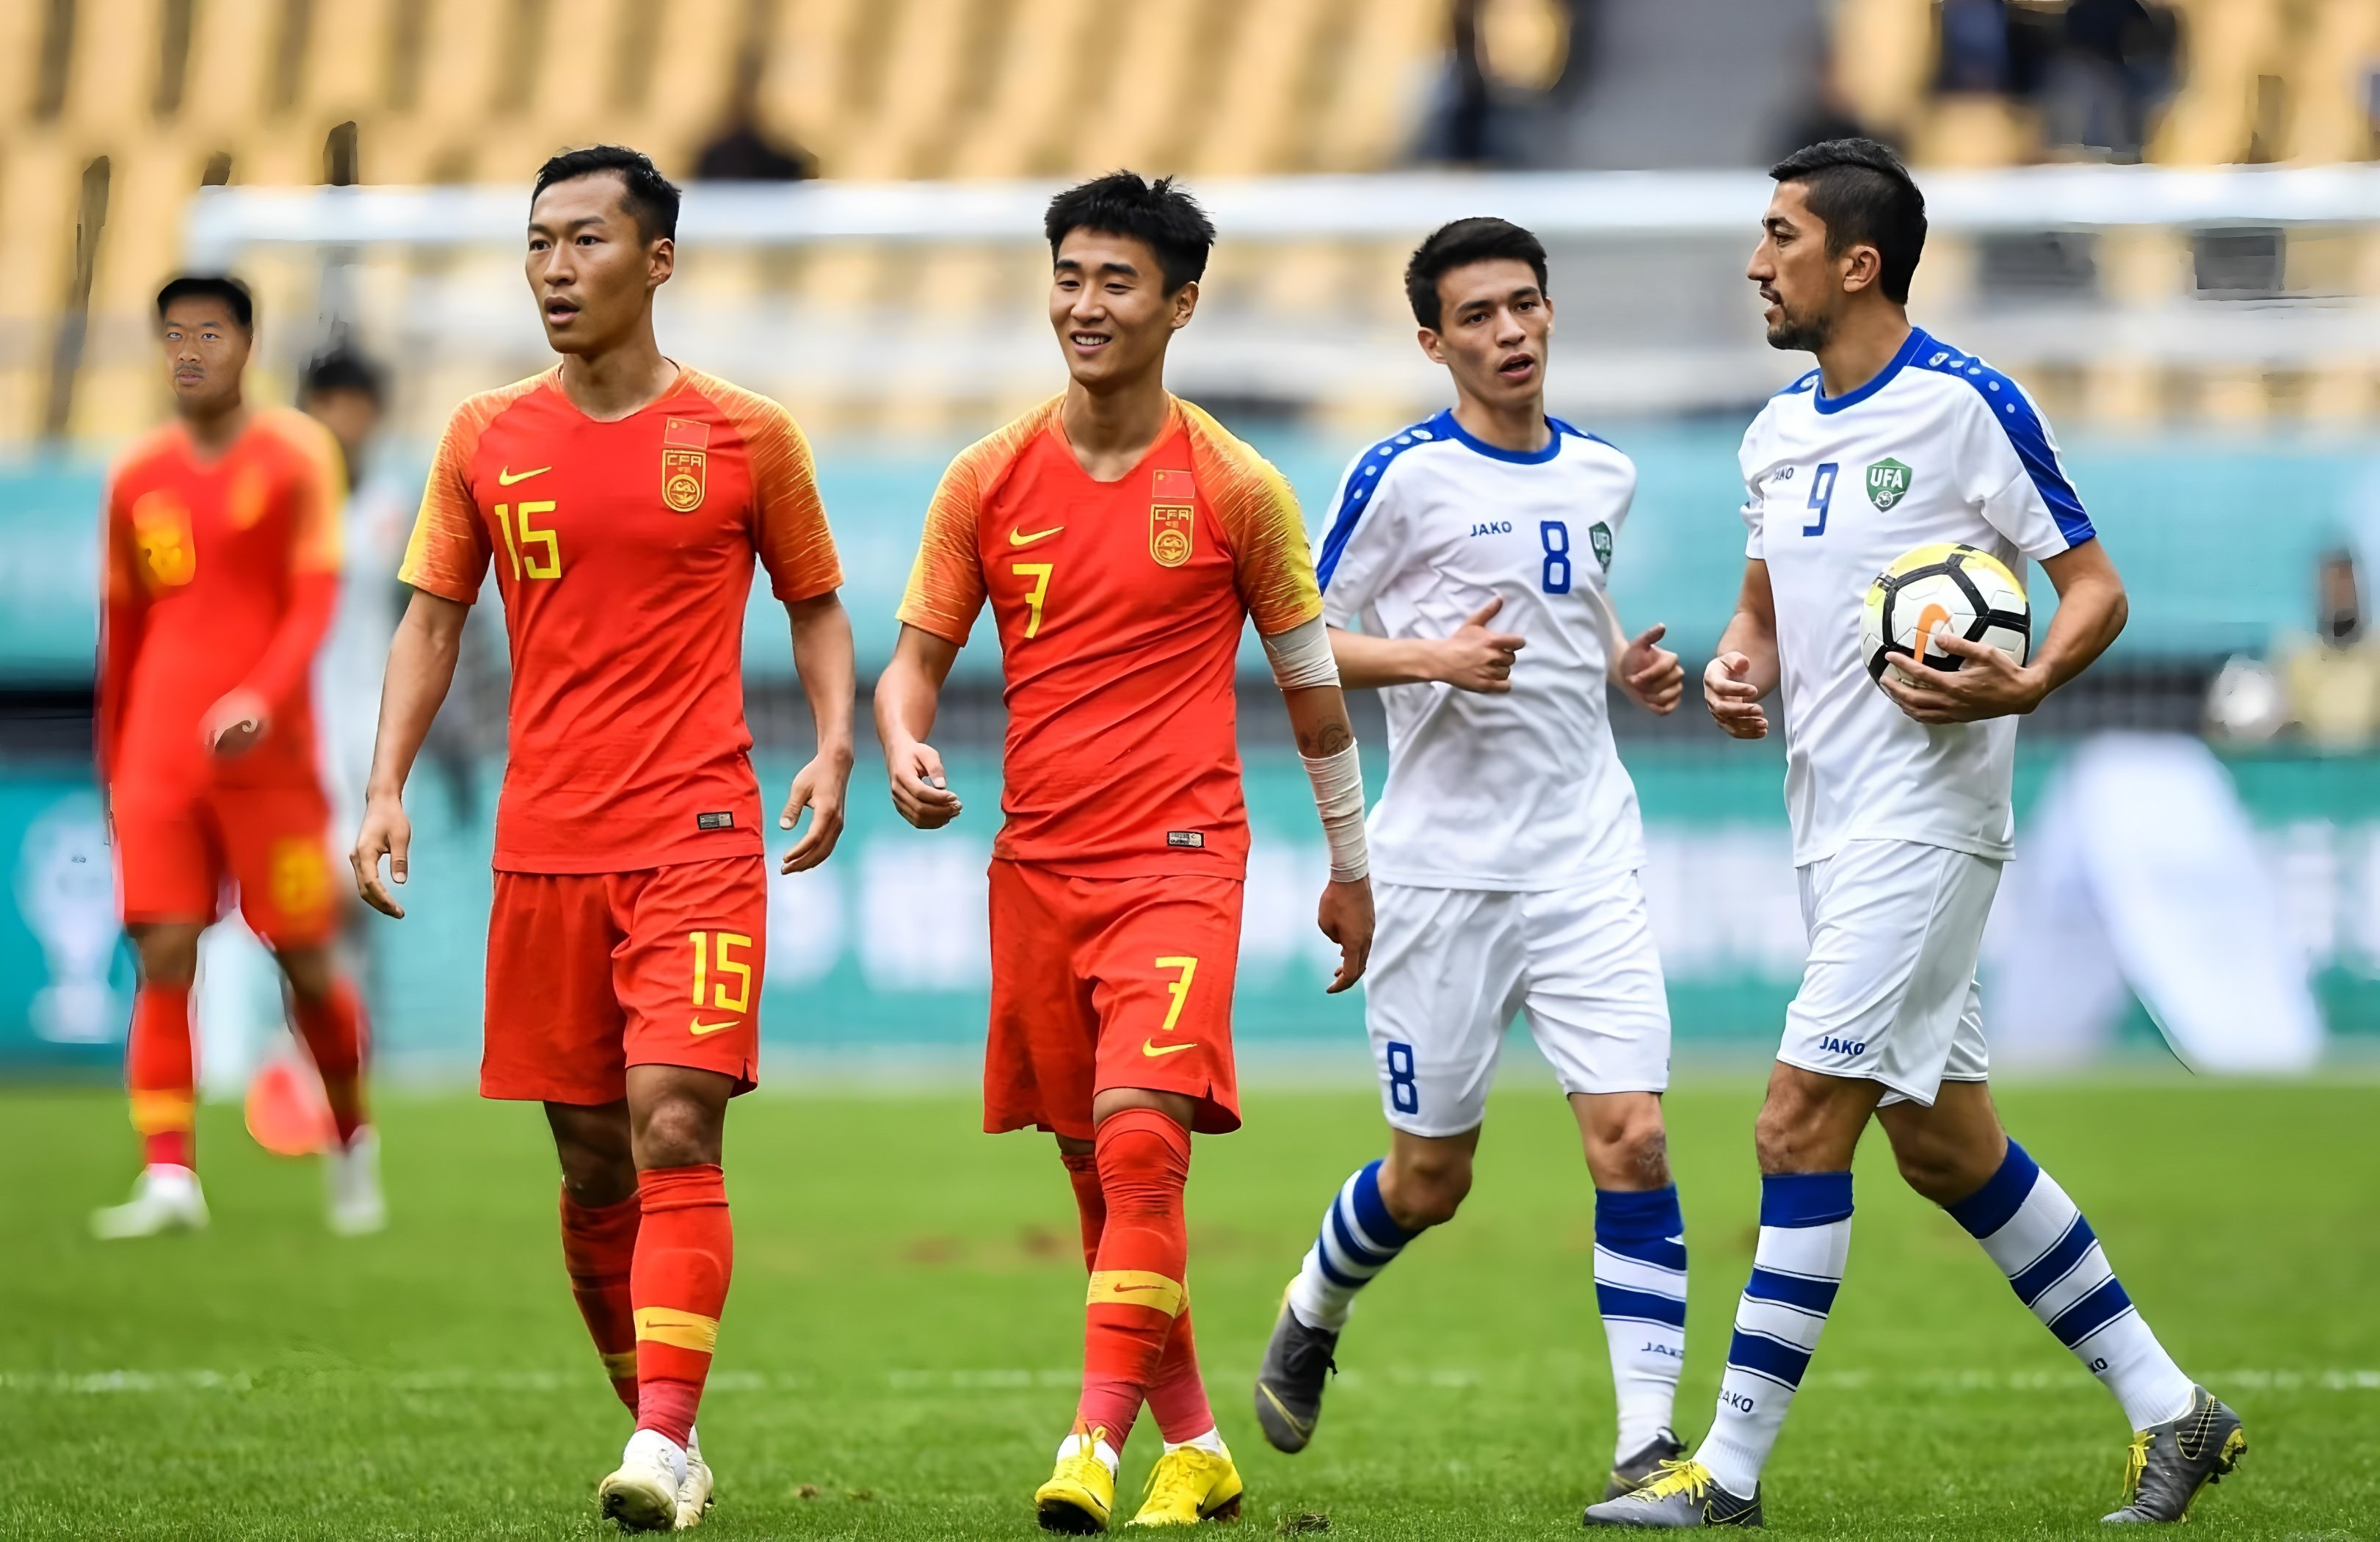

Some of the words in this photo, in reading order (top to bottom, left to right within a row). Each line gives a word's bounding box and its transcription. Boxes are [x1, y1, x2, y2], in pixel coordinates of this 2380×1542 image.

[667, 455, 702, 467] CFA
[1870, 468, 1903, 489] UFA
[1155, 509, 1189, 521] CFA
[1470, 521, 1512, 537] JAKO
[1802, 463, 1840, 537] 9
[494, 501, 562, 582] 15
[1539, 520, 1571, 595] 8
[1012, 563, 1053, 639] 7
[689, 931, 752, 1013] 15
[1155, 956, 1198, 1029] 7
[1387, 1040, 1418, 1115] 8
[1819, 1035, 1865, 1056] JAKO
